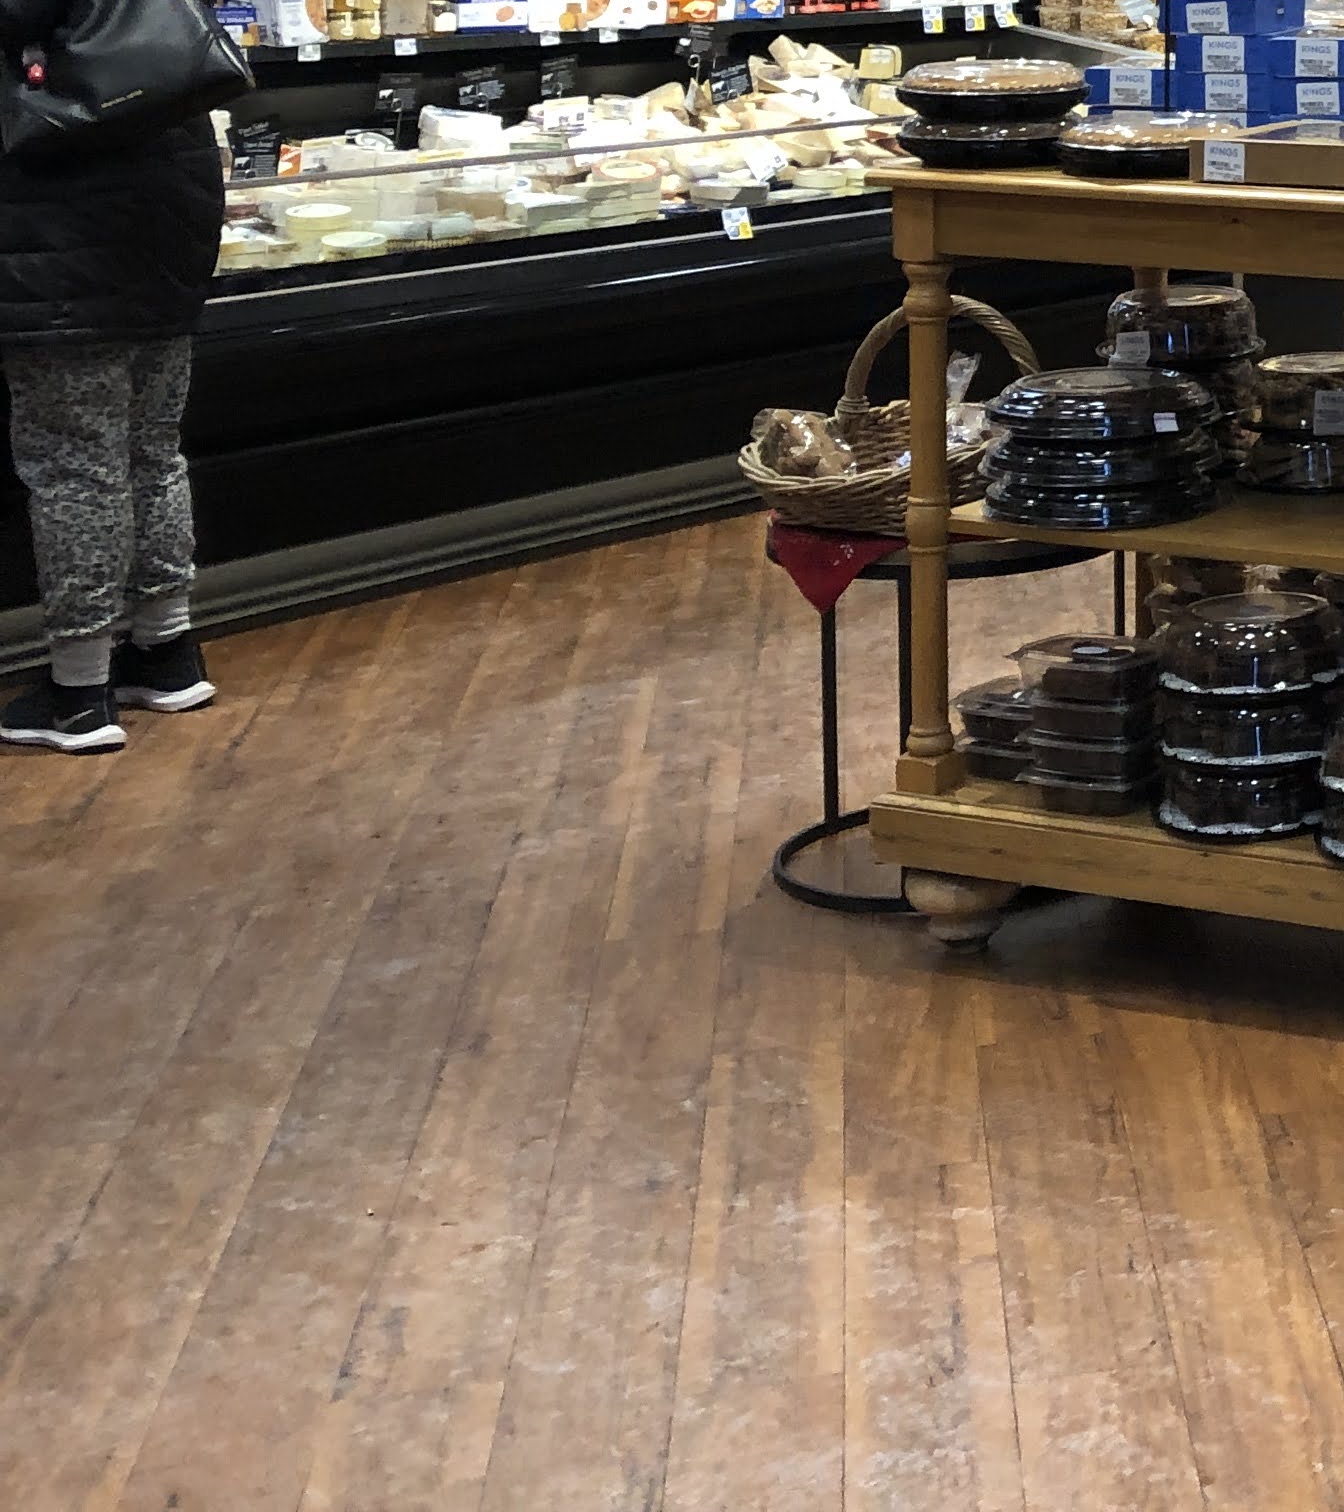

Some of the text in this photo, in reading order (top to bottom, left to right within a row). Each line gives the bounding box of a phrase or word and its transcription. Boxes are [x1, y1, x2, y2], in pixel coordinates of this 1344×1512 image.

[1192, 6, 1221, 16] KINGS
[1208, 40, 1238, 50] KINGS
[1302, 44, 1331, 55] KINGS
[1116, 73, 1145, 84] KINGS
[1211, 77, 1240, 88] KINGS
[1302, 86, 1332, 97] KINGS
[1210, 146, 1239, 158] KINGS
